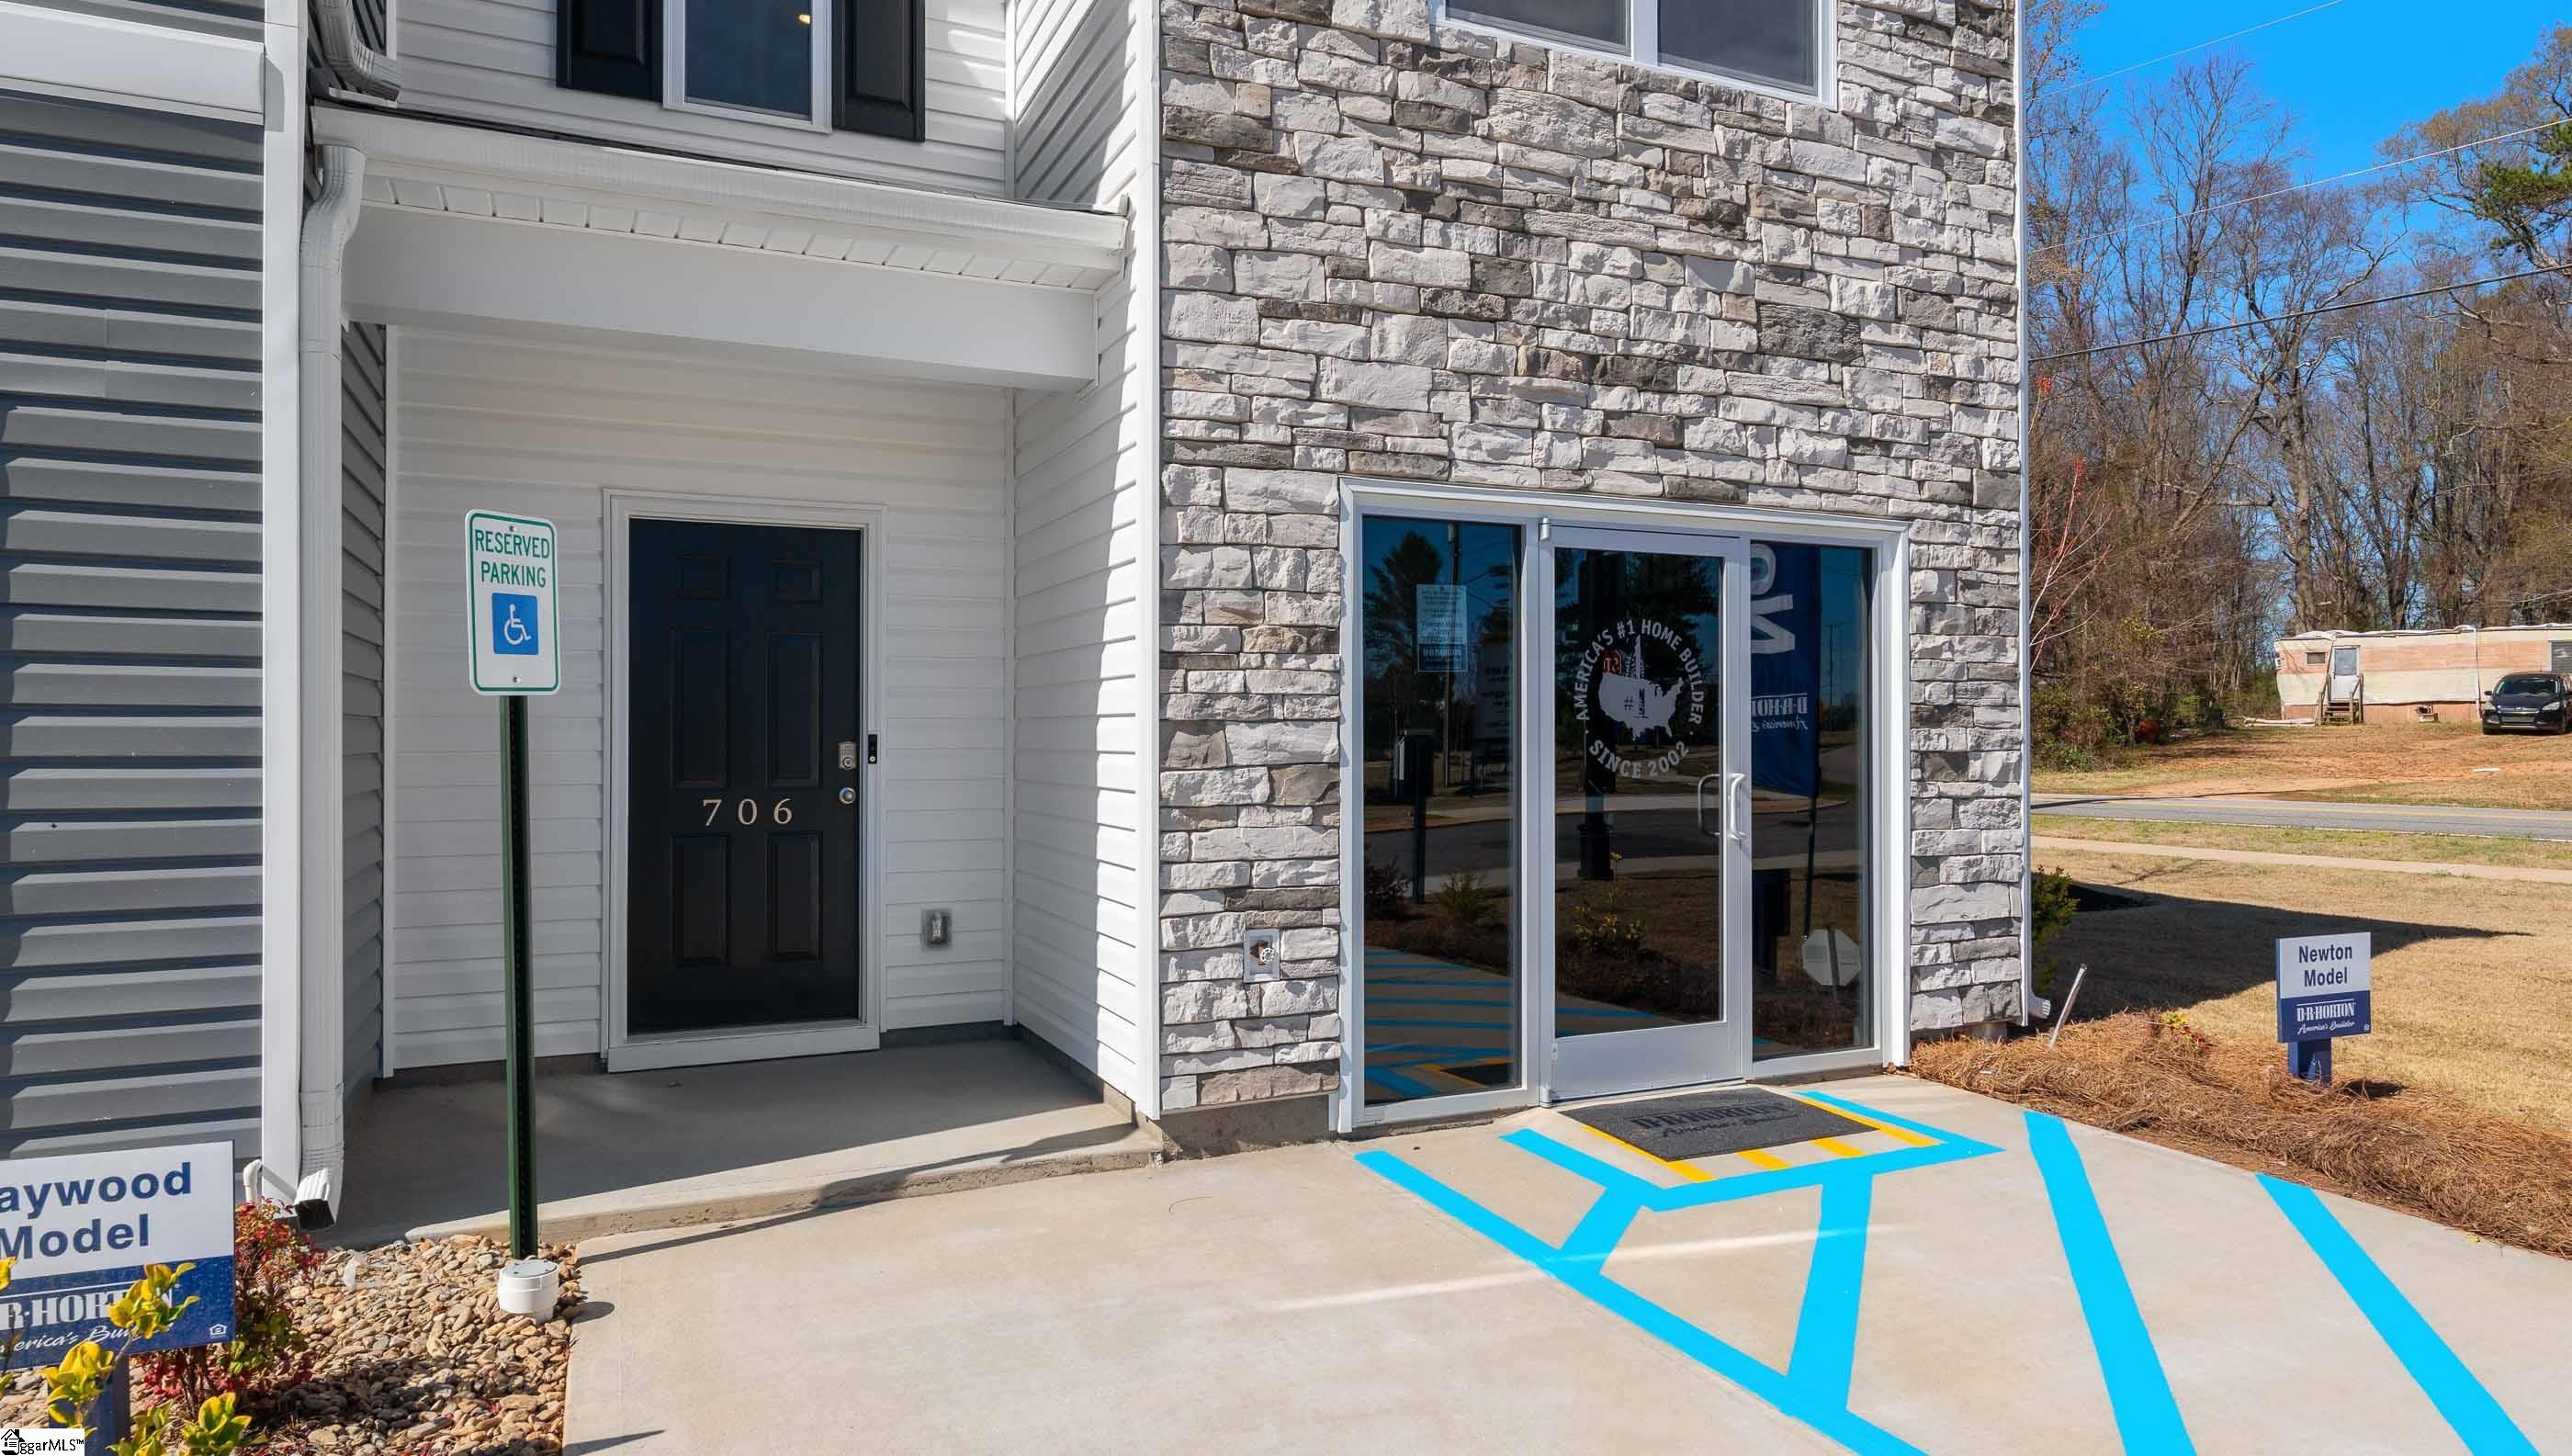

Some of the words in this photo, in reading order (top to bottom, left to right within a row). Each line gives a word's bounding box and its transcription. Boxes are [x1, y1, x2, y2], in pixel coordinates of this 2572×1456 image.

[475, 529, 550, 559] RESERVED
[480, 561, 547, 588] PARKING
[1574, 628, 1615, 721] AMERICA'S
[1616, 618, 1636, 639] #1
[1641, 618, 1682, 651] HOME
[1677, 647, 1705, 726] BUILDER
[1588, 739, 1643, 779] SINCE
[1647, 739, 1690, 778] 2002
[702, 798, 794, 827] 706
[2298, 943, 2352, 964] Newton
[2304, 966, 2349, 988] Model
[0, 1161, 191, 1219] aywood
[0, 1213, 150, 1260] Model
